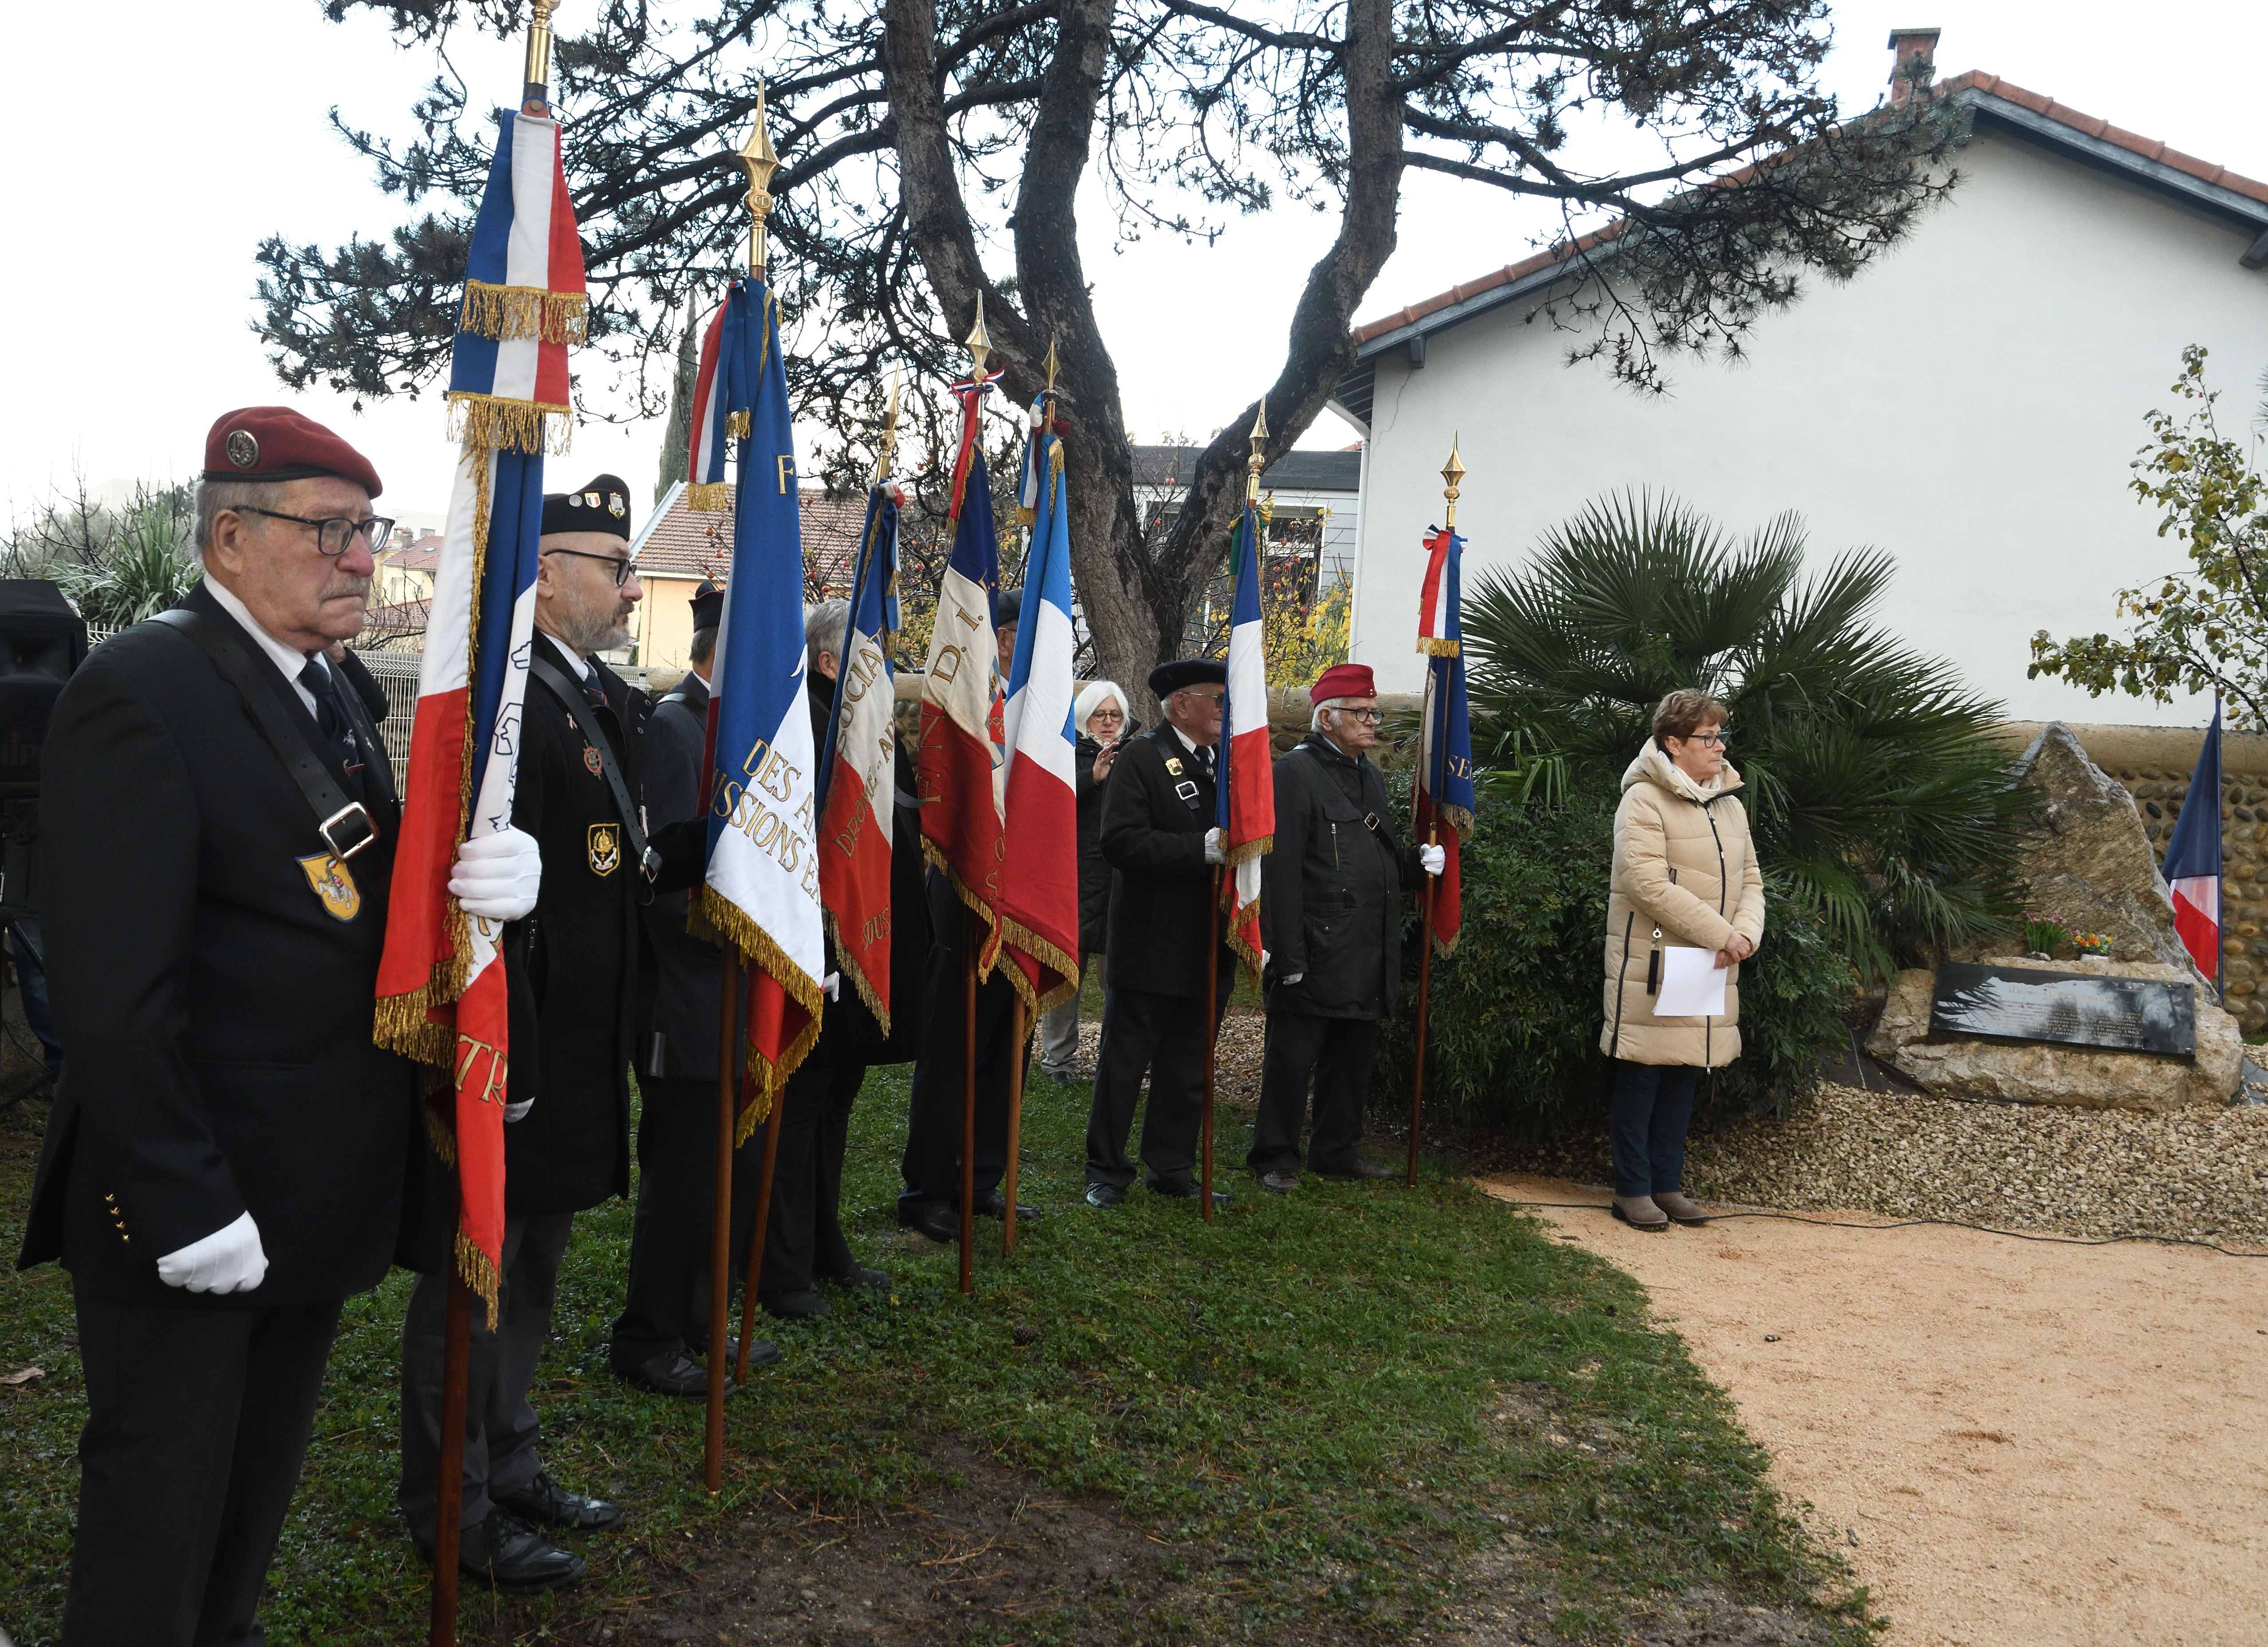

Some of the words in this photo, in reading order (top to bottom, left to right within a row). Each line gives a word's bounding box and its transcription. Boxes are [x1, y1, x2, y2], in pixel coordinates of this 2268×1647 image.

[776, 454, 796, 495] F
[742, 737, 801, 802] DES
[1447, 755, 1472, 780] SE
[710, 768, 806, 872] ISSIONS
[862, 904, 890, 953] SOUS
